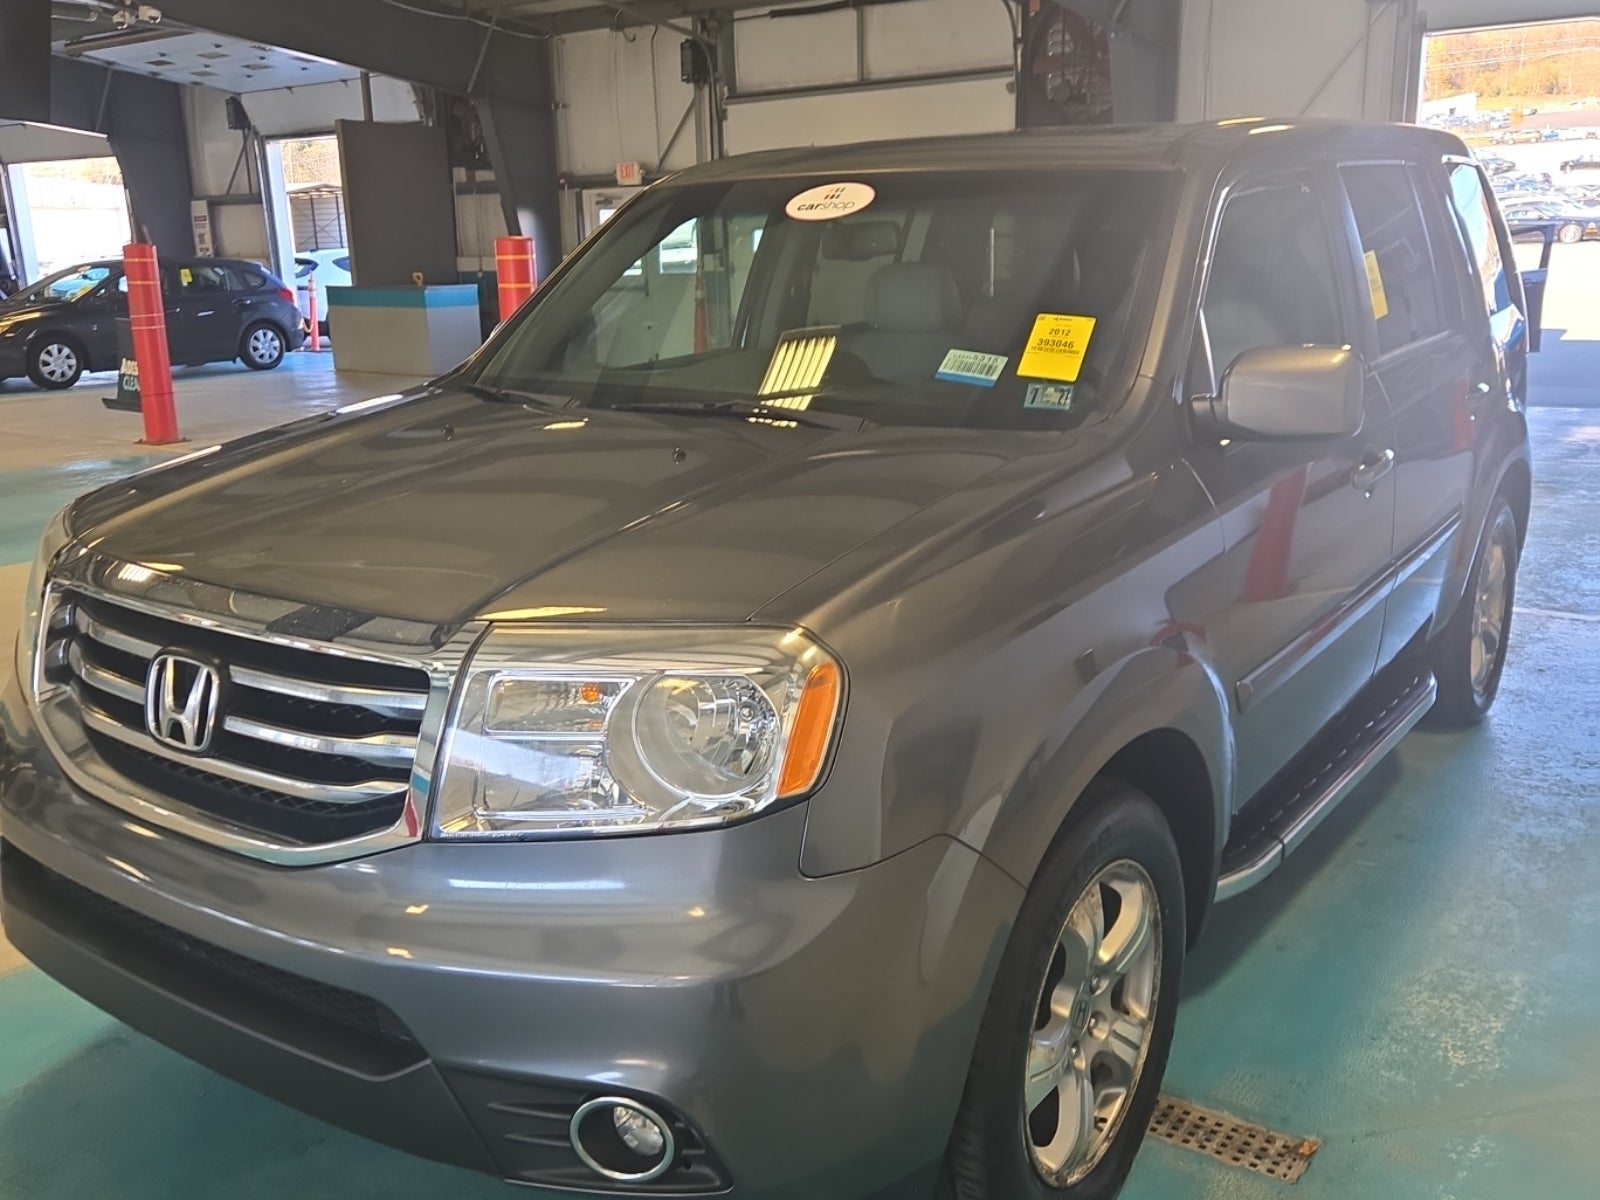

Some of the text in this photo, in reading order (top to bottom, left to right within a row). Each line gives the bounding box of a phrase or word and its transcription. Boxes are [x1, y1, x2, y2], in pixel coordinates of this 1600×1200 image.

[797, 201, 856, 212] carshop
[1048, 327, 1071, 337] 2012
[1036, 338, 1075, 349] 393046
